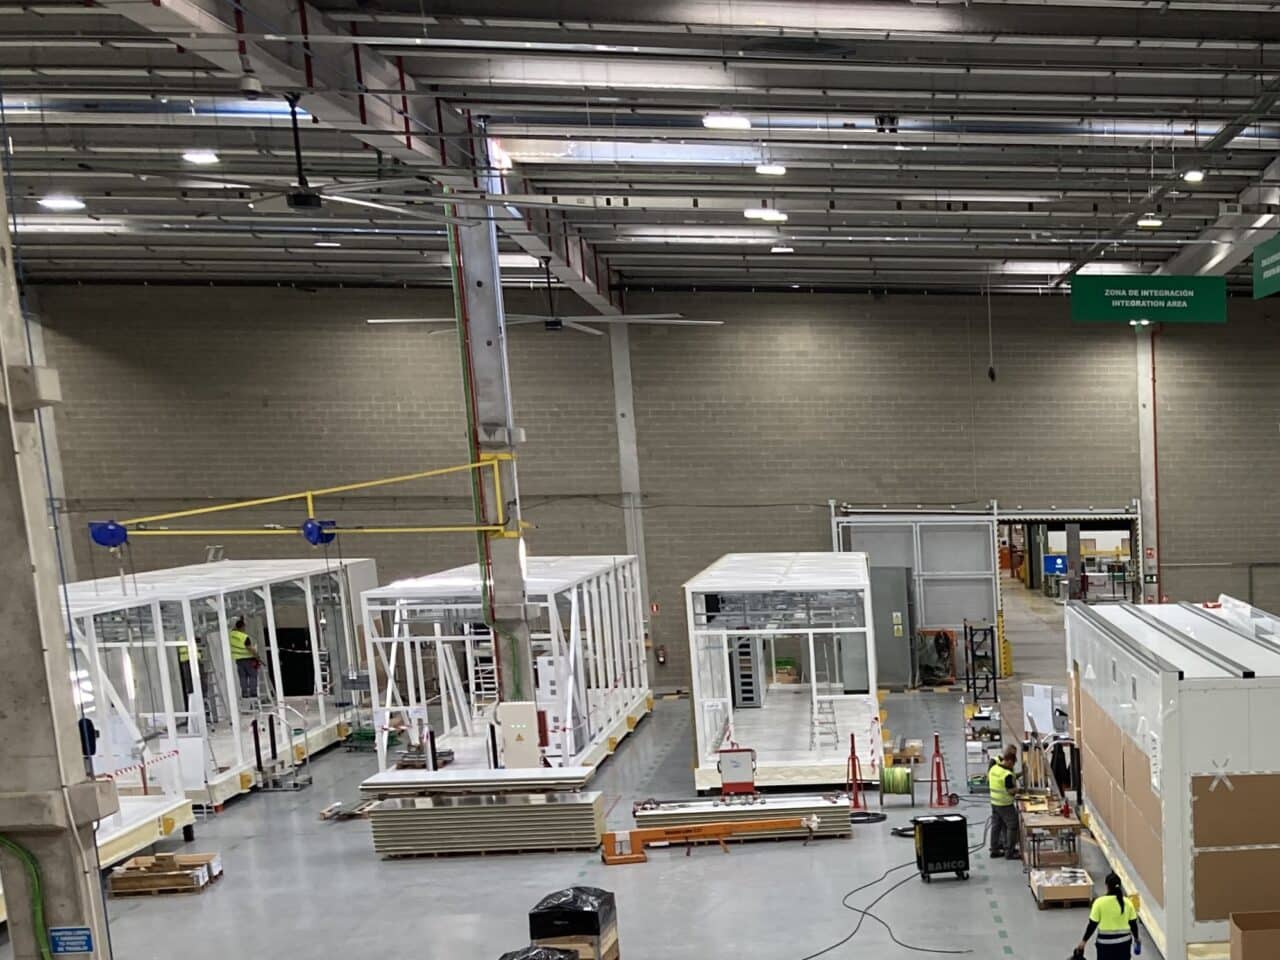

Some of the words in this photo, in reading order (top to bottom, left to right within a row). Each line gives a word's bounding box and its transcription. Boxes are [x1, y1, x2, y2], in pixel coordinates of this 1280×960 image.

[1104, 289, 1127, 297] ZONA
[1128, 289, 1139, 297] DE
[1140, 288, 1195, 297] INTEGRACIÓN
[1166, 300, 1188, 308] AREA
